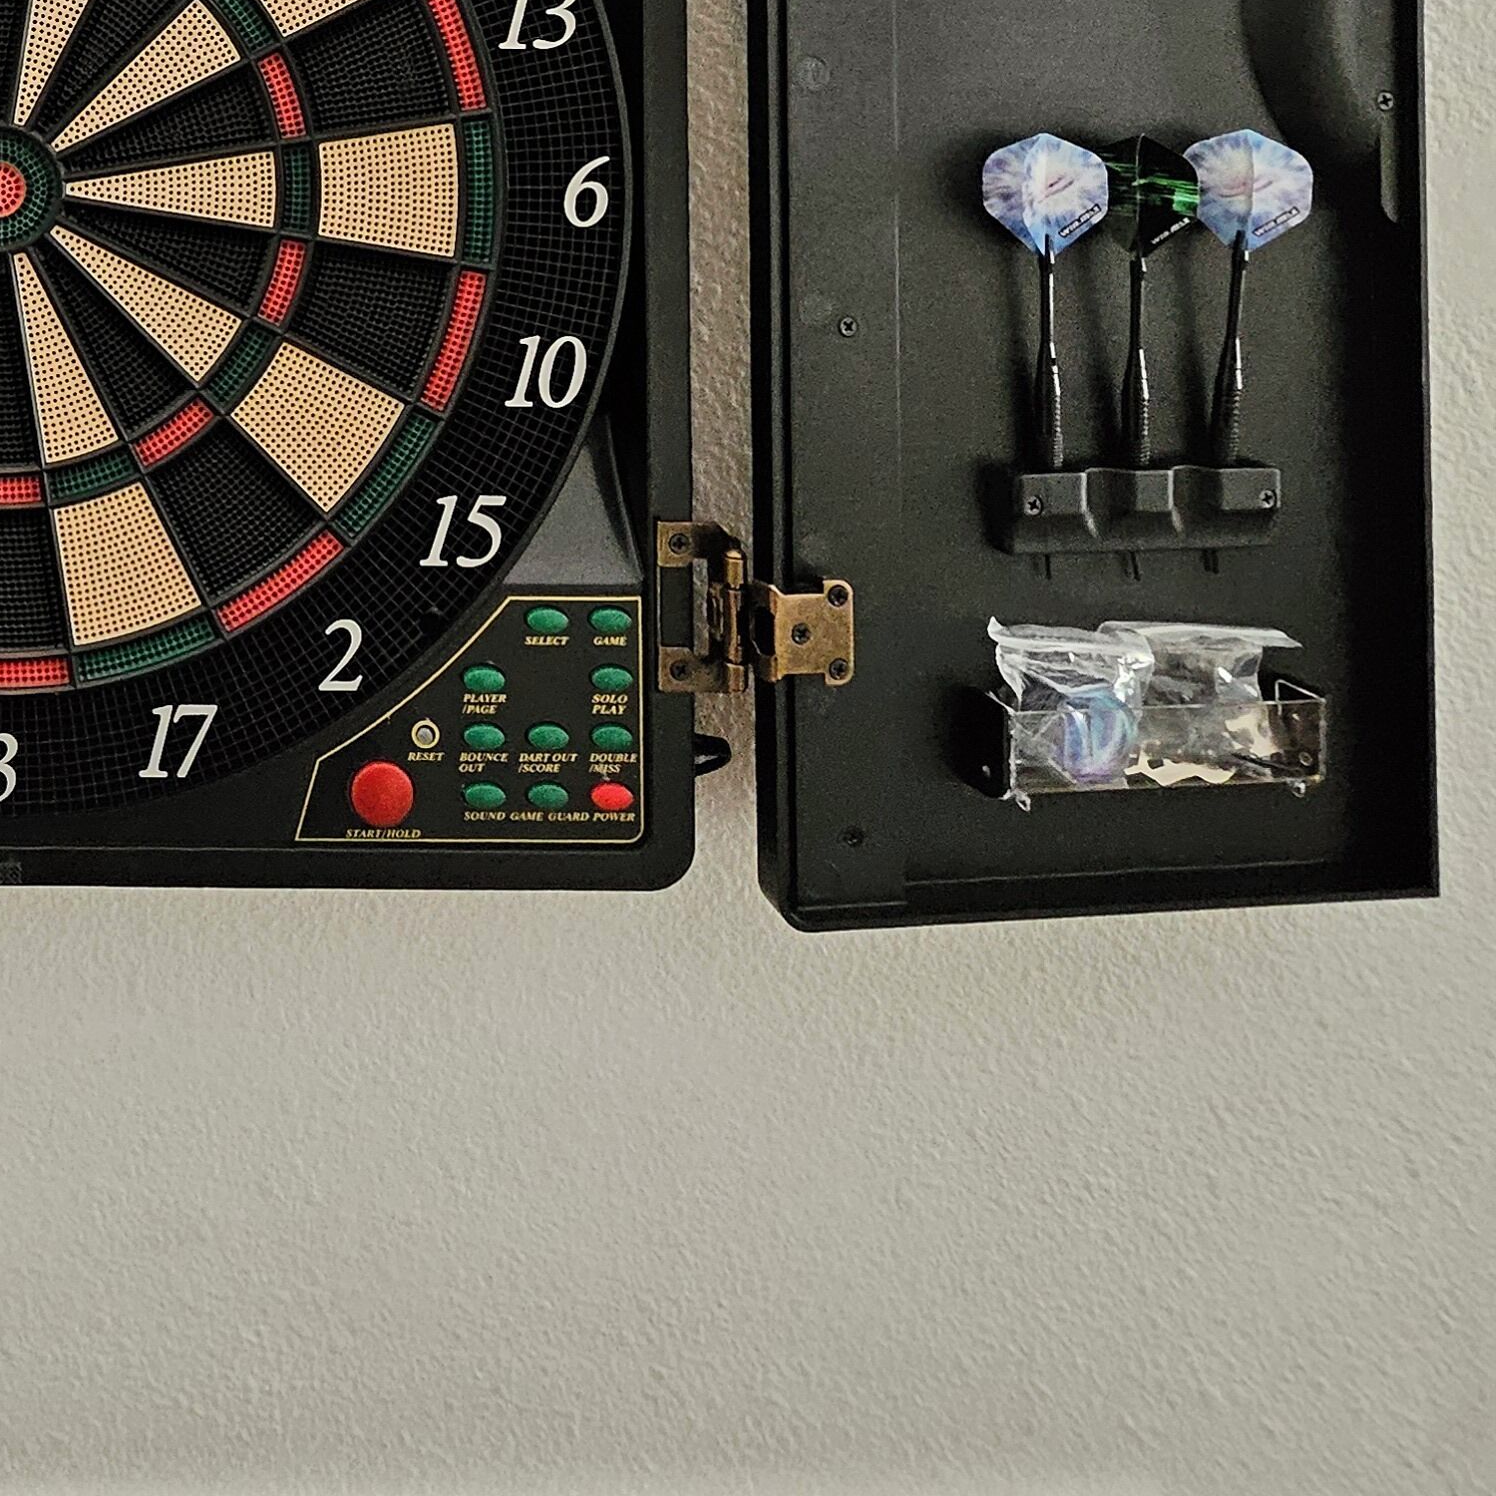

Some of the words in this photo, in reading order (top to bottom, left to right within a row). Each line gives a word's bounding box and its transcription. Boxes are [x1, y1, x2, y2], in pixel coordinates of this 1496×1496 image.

[564, 156, 610, 227] 6
[505, 335, 586, 408] 10
[420, 495, 506, 567] 15
[525, 636, 569, 645] SELECT
[594, 637, 626, 645] GAME
[319, 619, 362, 691] 2
[464, 694, 506, 702] PLAYER
[592, 694, 627, 703] SOLO
[463, 705, 497, 714] /PAGE
[592, 705, 626, 714] PLAY
[142, 704, 217, 777] 17
[408, 752, 444, 761] RESET
[460, 753, 508, 761] BOUNCE
[519, 753, 550, 762] DART
[552, 754, 577, 762] OUT
[590, 753, 637, 762] DOUBLE
[459, 764, 485, 772] OUT
[519, 764, 560, 772] /SCORE
[589, 764, 620, 773] /MISS
[464, 812, 505, 820] SOUND
[510, 812, 543, 821] GAME
[548, 812, 589, 821] GUARD
[593, 813, 635, 821] POWER
[345, 829, 422, 839] START/HOLD
